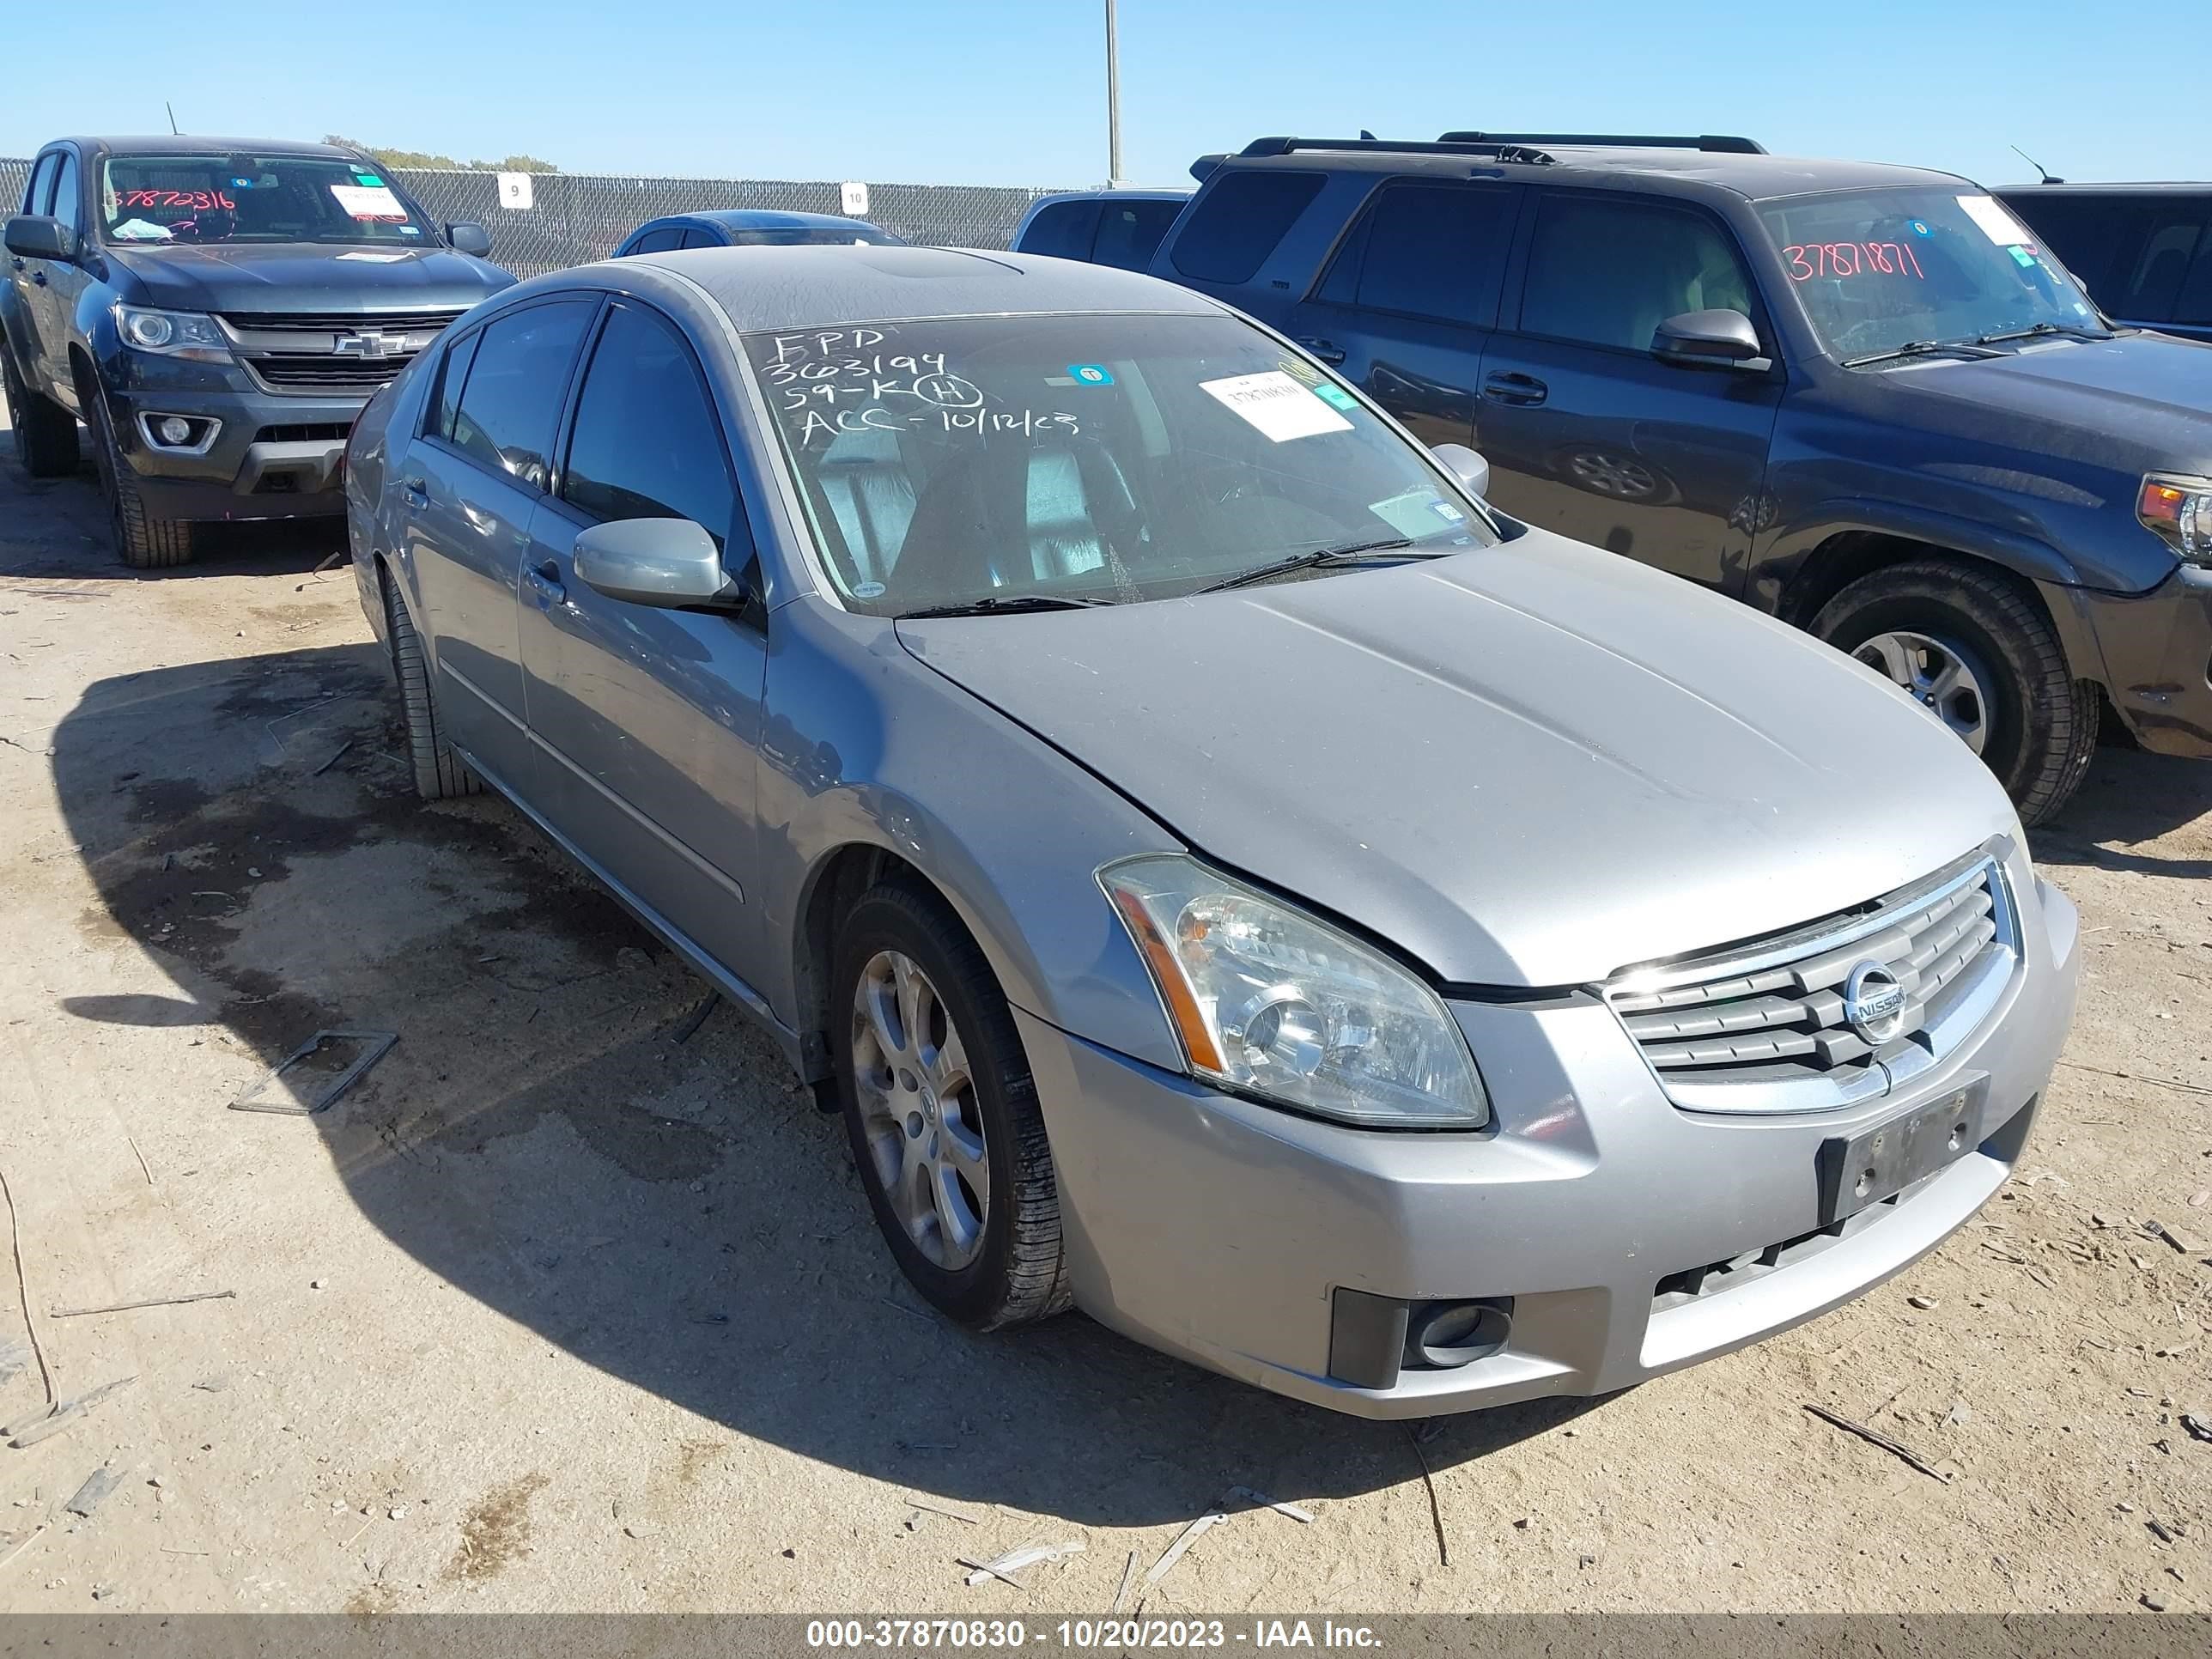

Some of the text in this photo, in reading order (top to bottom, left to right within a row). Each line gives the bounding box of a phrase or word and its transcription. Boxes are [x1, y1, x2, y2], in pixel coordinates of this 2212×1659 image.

[103, 187, 235, 210] 37872316
[511, 185, 520, 198] 9
[850, 192, 862, 204] 10
[1783, 243, 1923, 280] 37871871
[1858, 988, 1905, 1018] NISSAN
